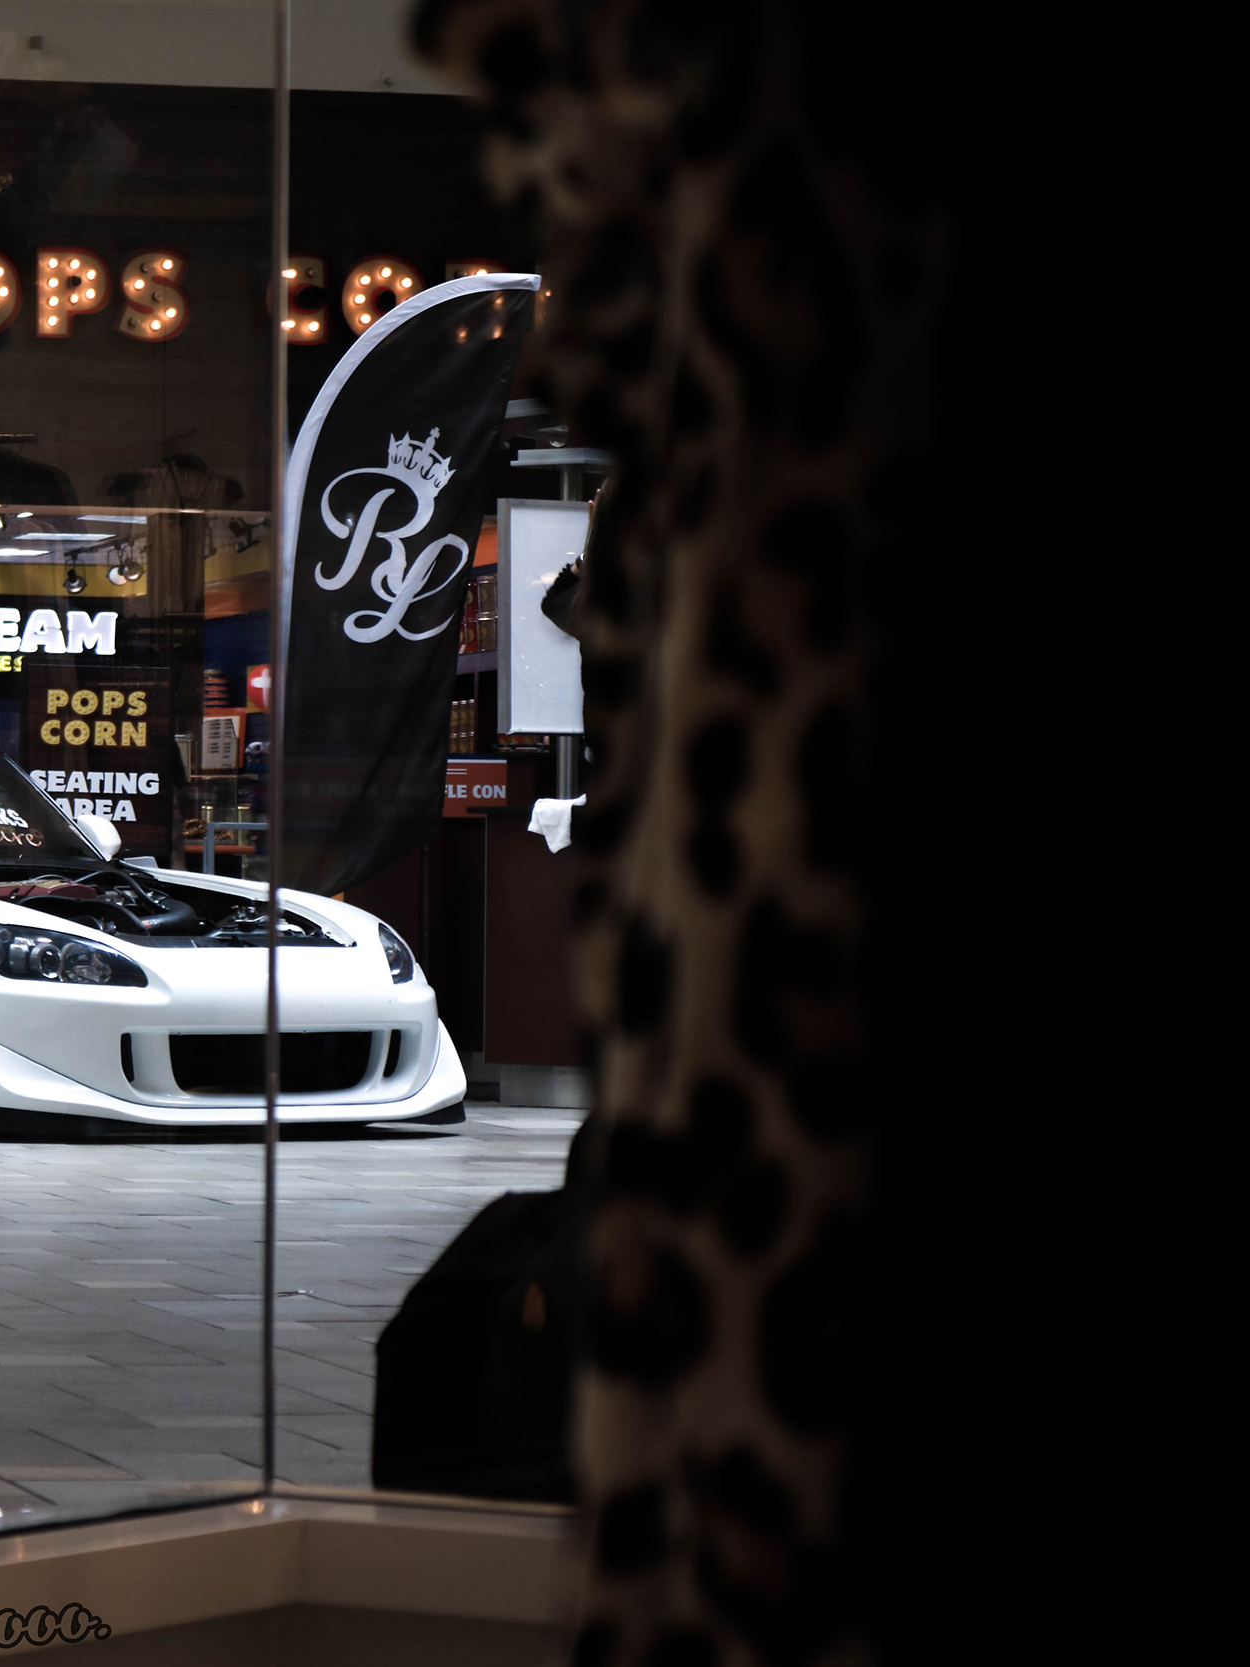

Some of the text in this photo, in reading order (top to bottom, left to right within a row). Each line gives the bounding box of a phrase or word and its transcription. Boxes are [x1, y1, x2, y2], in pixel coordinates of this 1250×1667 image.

[46, 689, 148, 717] POPS
[40, 719, 147, 747] CORN
[29, 769, 160, 796] SEATING
[472, 784, 507, 799] CON
[54, 797, 137, 822] AREA
